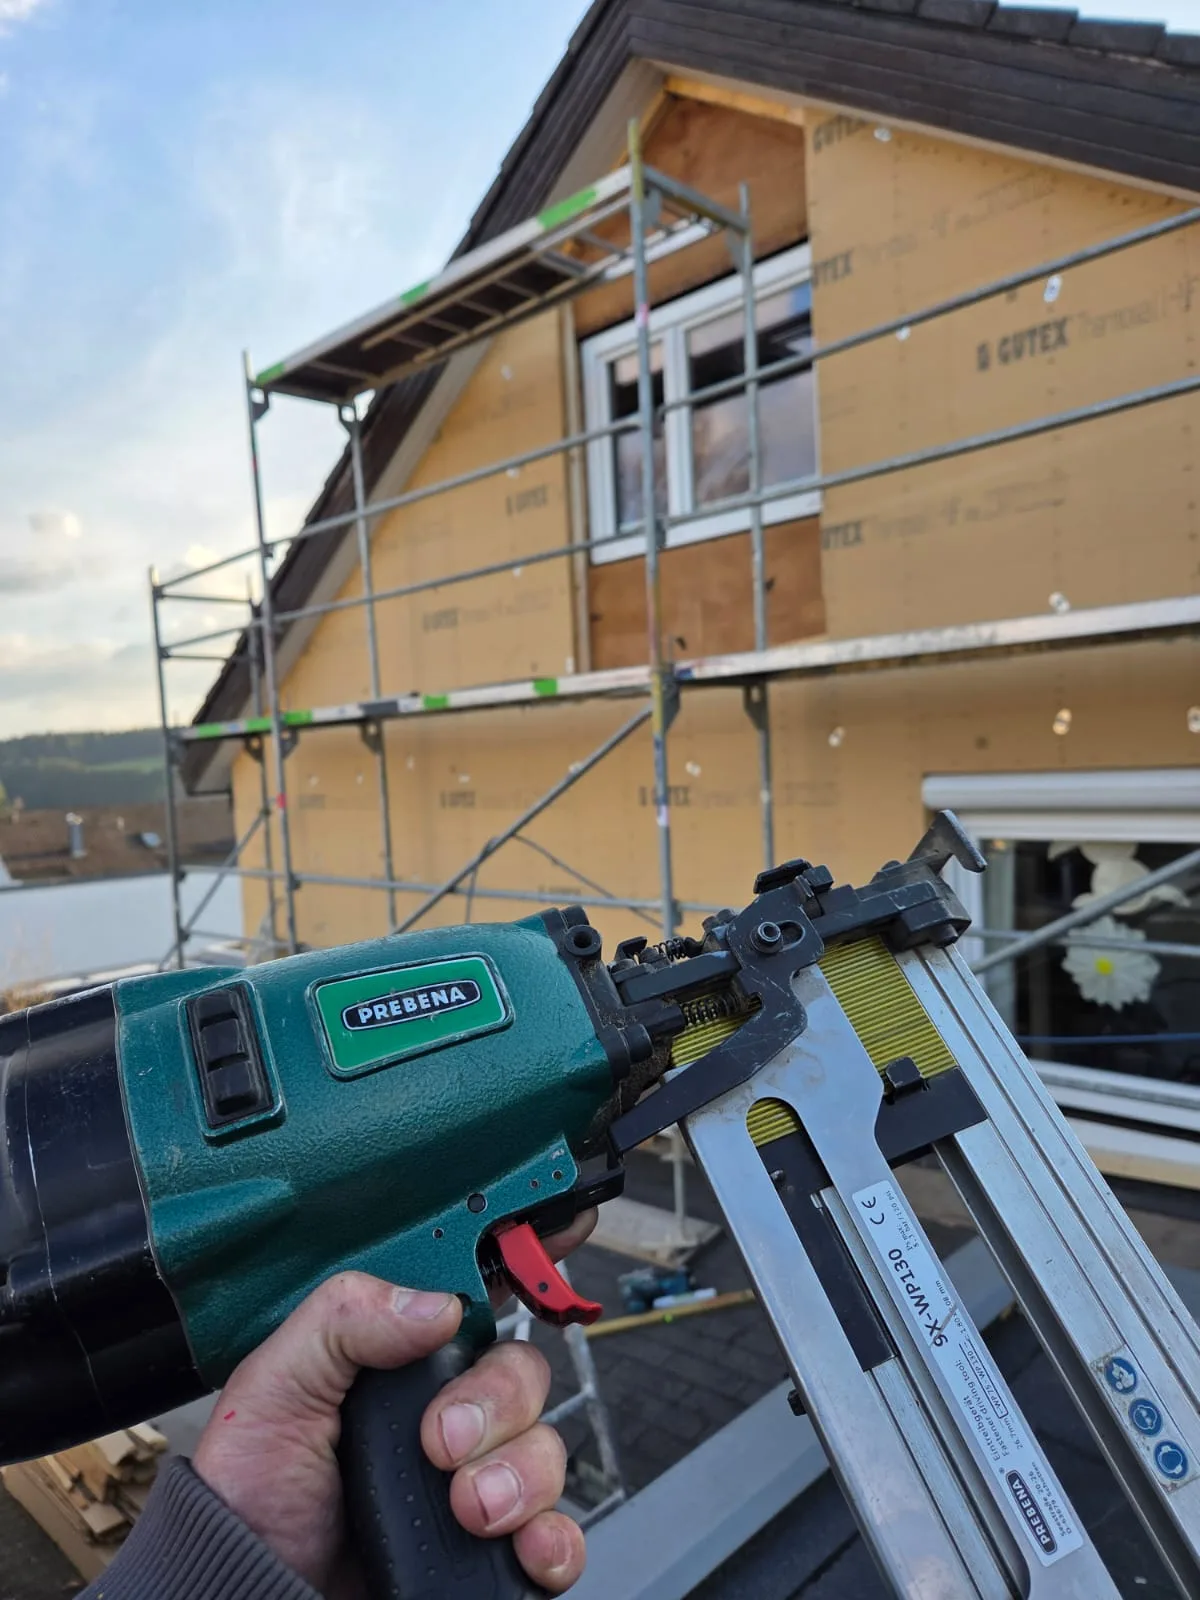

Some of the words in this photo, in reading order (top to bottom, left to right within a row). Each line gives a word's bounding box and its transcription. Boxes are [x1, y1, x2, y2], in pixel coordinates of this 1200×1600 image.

[997, 317, 1069, 366] GUTEX
[358, 986, 466, 1024] PREBENA
[888, 1248, 948, 1348] 9X-WP130
[953, 1358, 971, 1382] tool:
[965, 1349, 978, 1365] 130
[964, 1379, 989, 1416] driving
[960, 1393, 1003, 1463] Eintreibgerät
[983, 1414, 1010, 1457] Fastener
[1011, 1478, 1051, 1545] PREBENA
